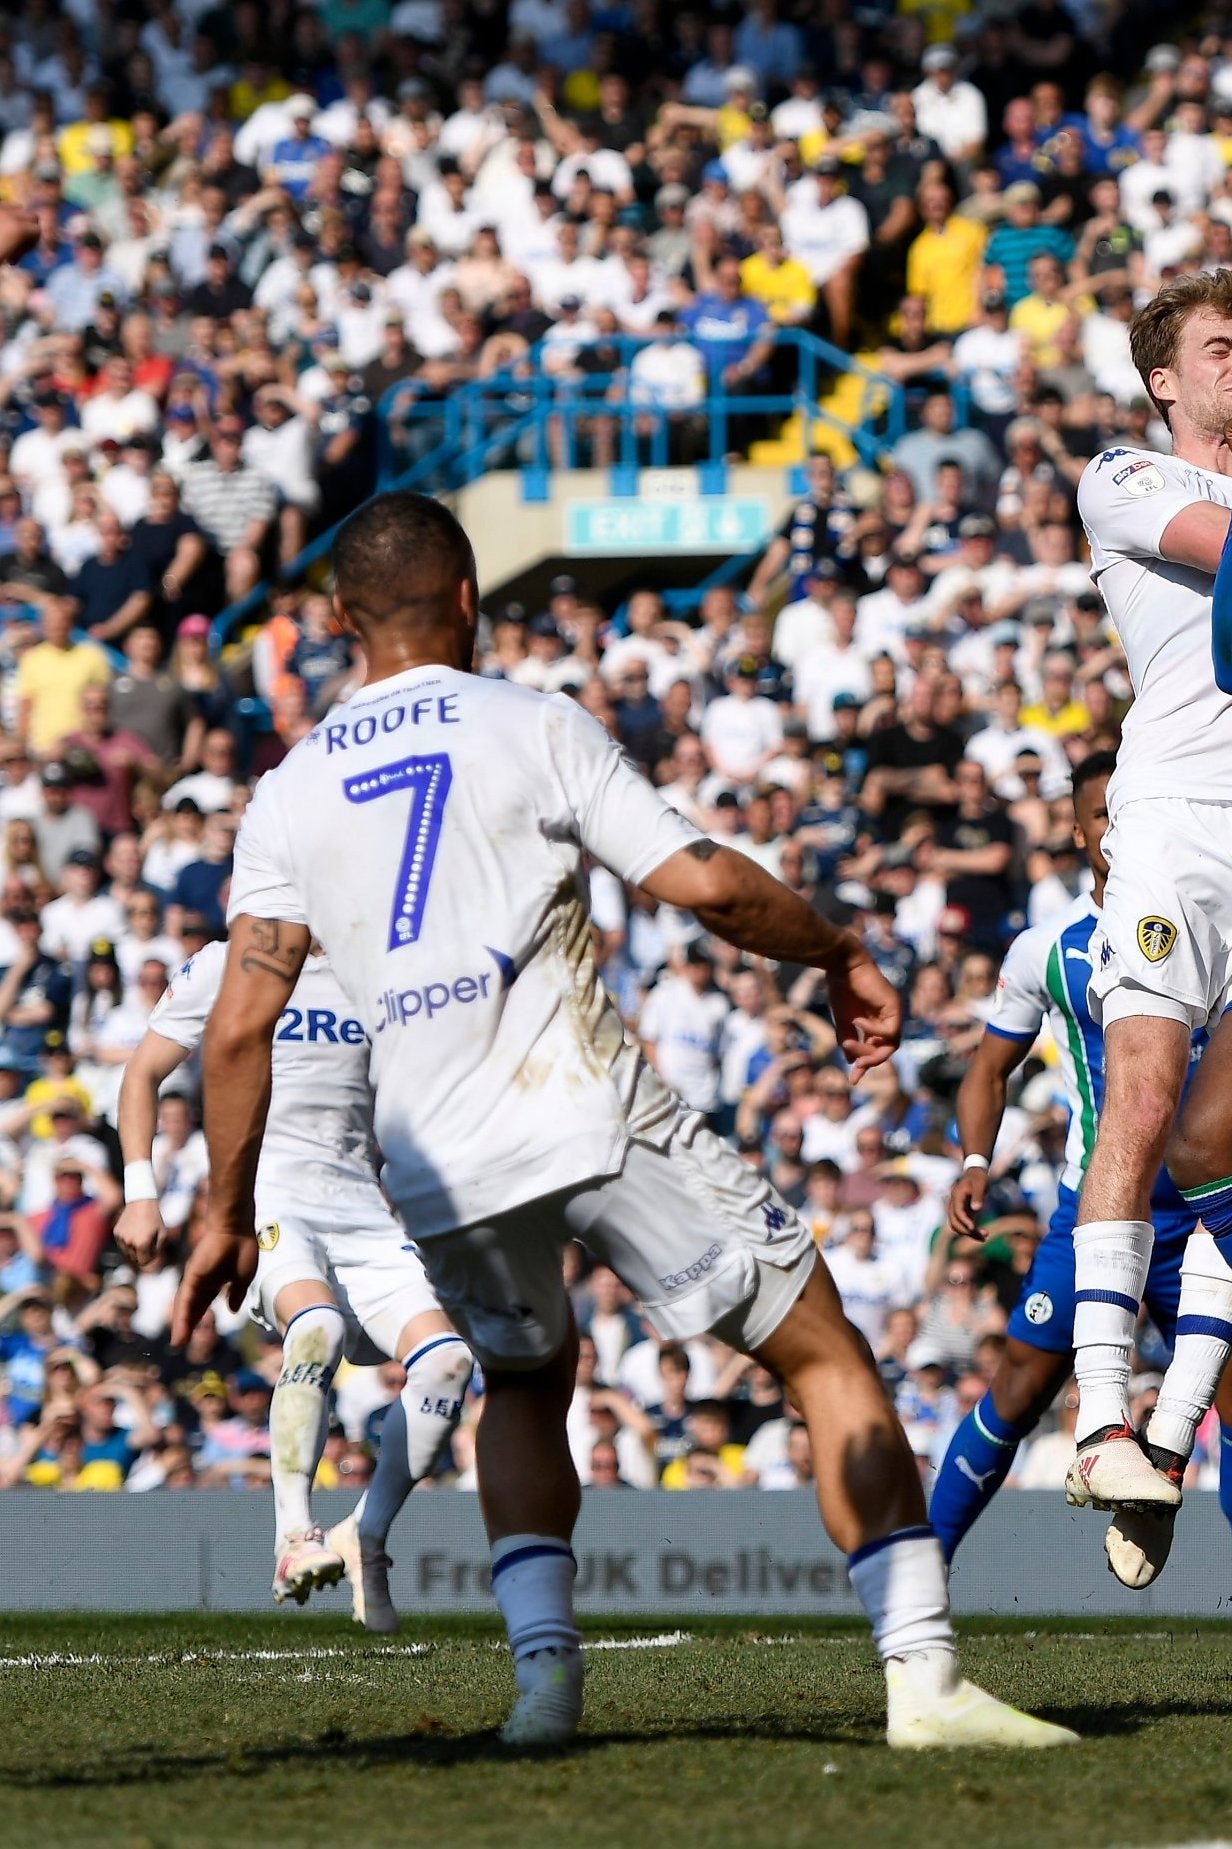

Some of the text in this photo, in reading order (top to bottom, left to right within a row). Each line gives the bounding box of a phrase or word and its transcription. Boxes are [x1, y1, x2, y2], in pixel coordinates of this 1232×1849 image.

[326, 692, 461, 755] ROOFE
[342, 751, 453, 954] 7
[657, 1243, 723, 1291] Kappa
